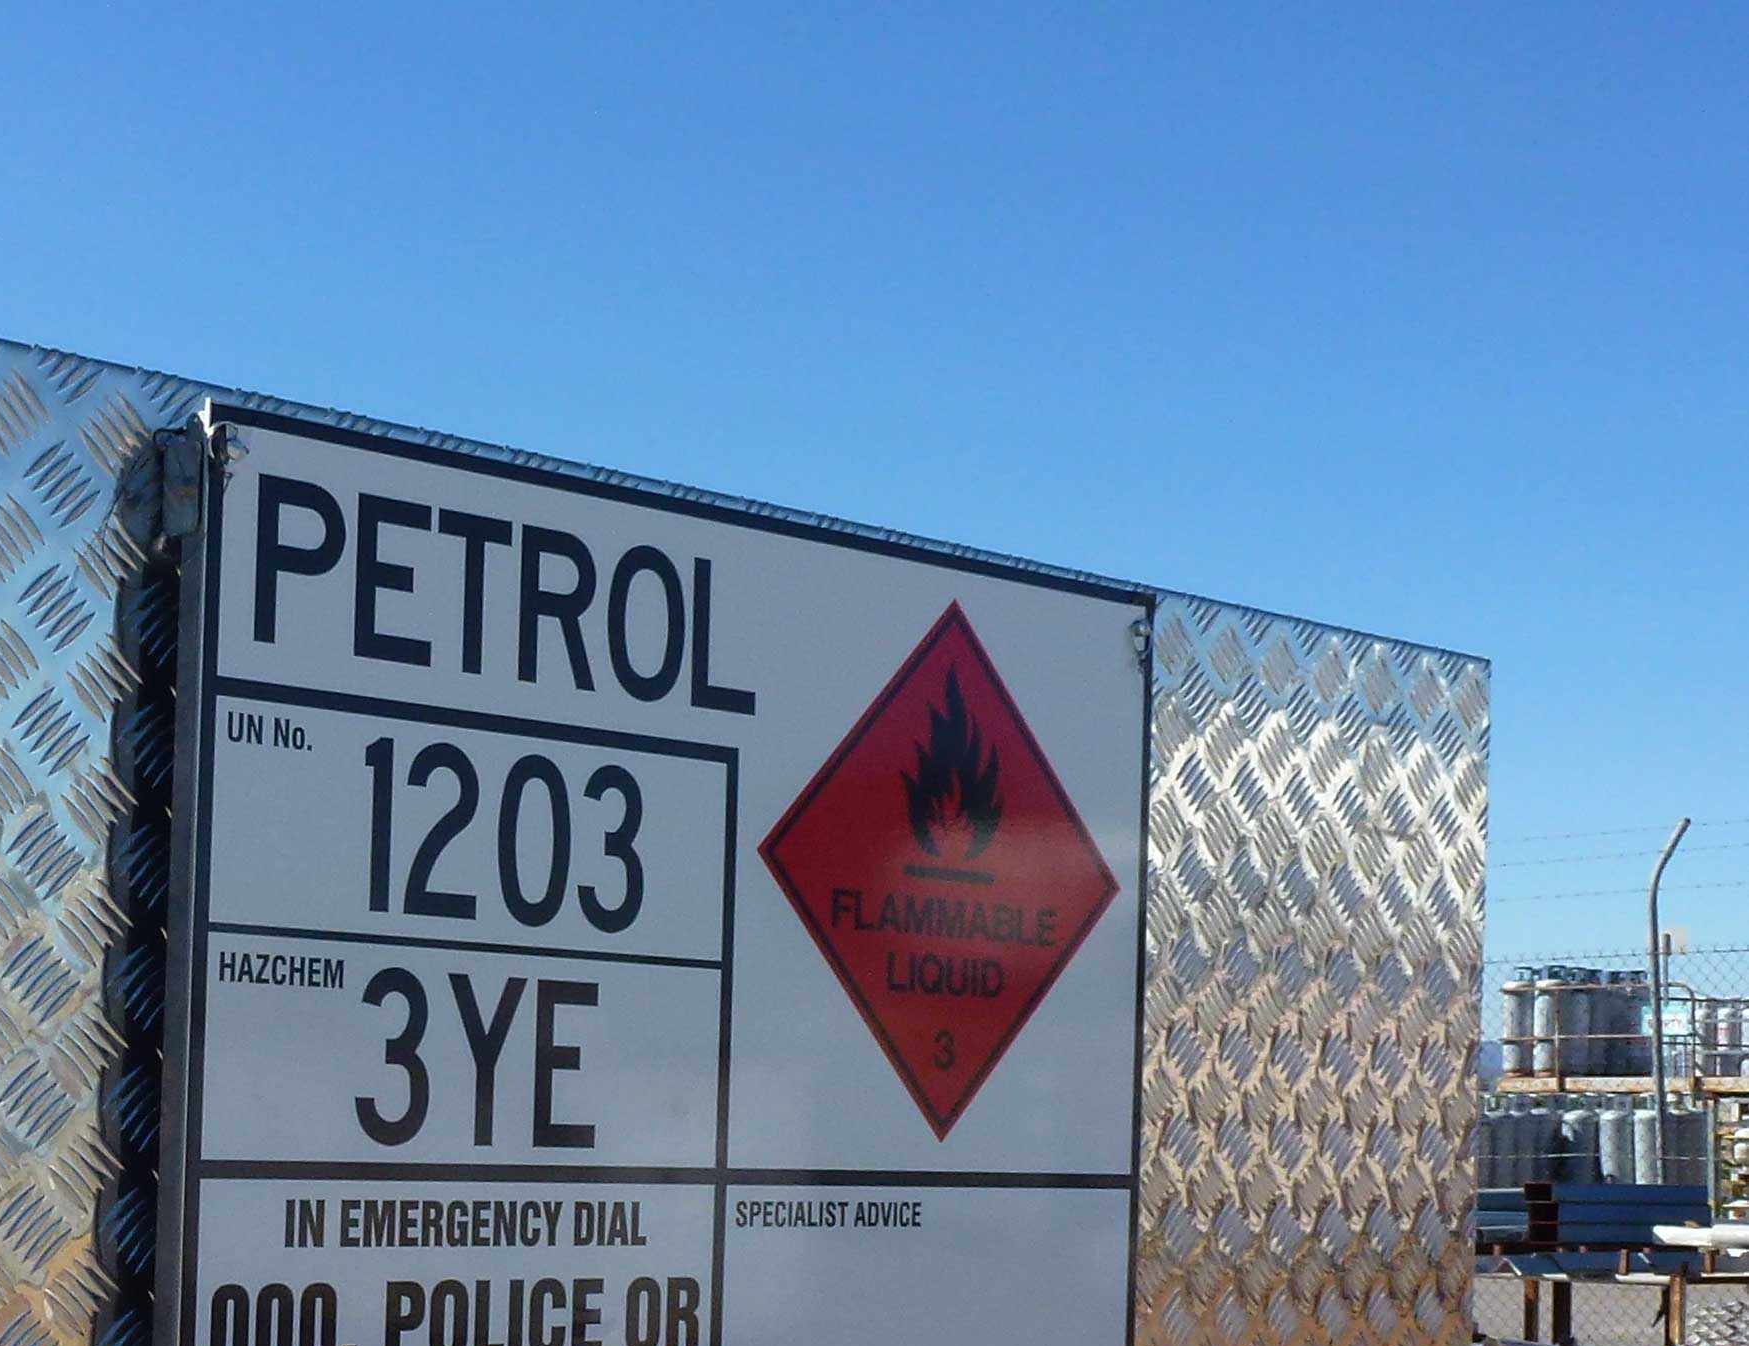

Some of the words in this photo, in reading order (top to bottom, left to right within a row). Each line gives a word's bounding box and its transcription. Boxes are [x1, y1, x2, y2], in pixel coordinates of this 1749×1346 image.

[253, 473, 757, 716] PETROL
[227, 711, 264, 745] UN
[273, 717, 313, 752] No.
[365, 736, 644, 935] 1203
[830, 888, 1058, 947] FLAMMABLE
[218, 951, 345, 990] HAZCHEM
[886, 951, 1006, 998] LIQUID
[354, 967, 600, 1148] 3YE
[932, 1028, 956, 1071] 3
[284, 1199, 326, 1248] IN
[339, 1199, 562, 1248] EMERGENCY
[573, 1200, 647, 1247] DIAL
[735, 1200, 848, 1228] SPECIALIST
[853, 1201, 922, 1228] ADVICE
